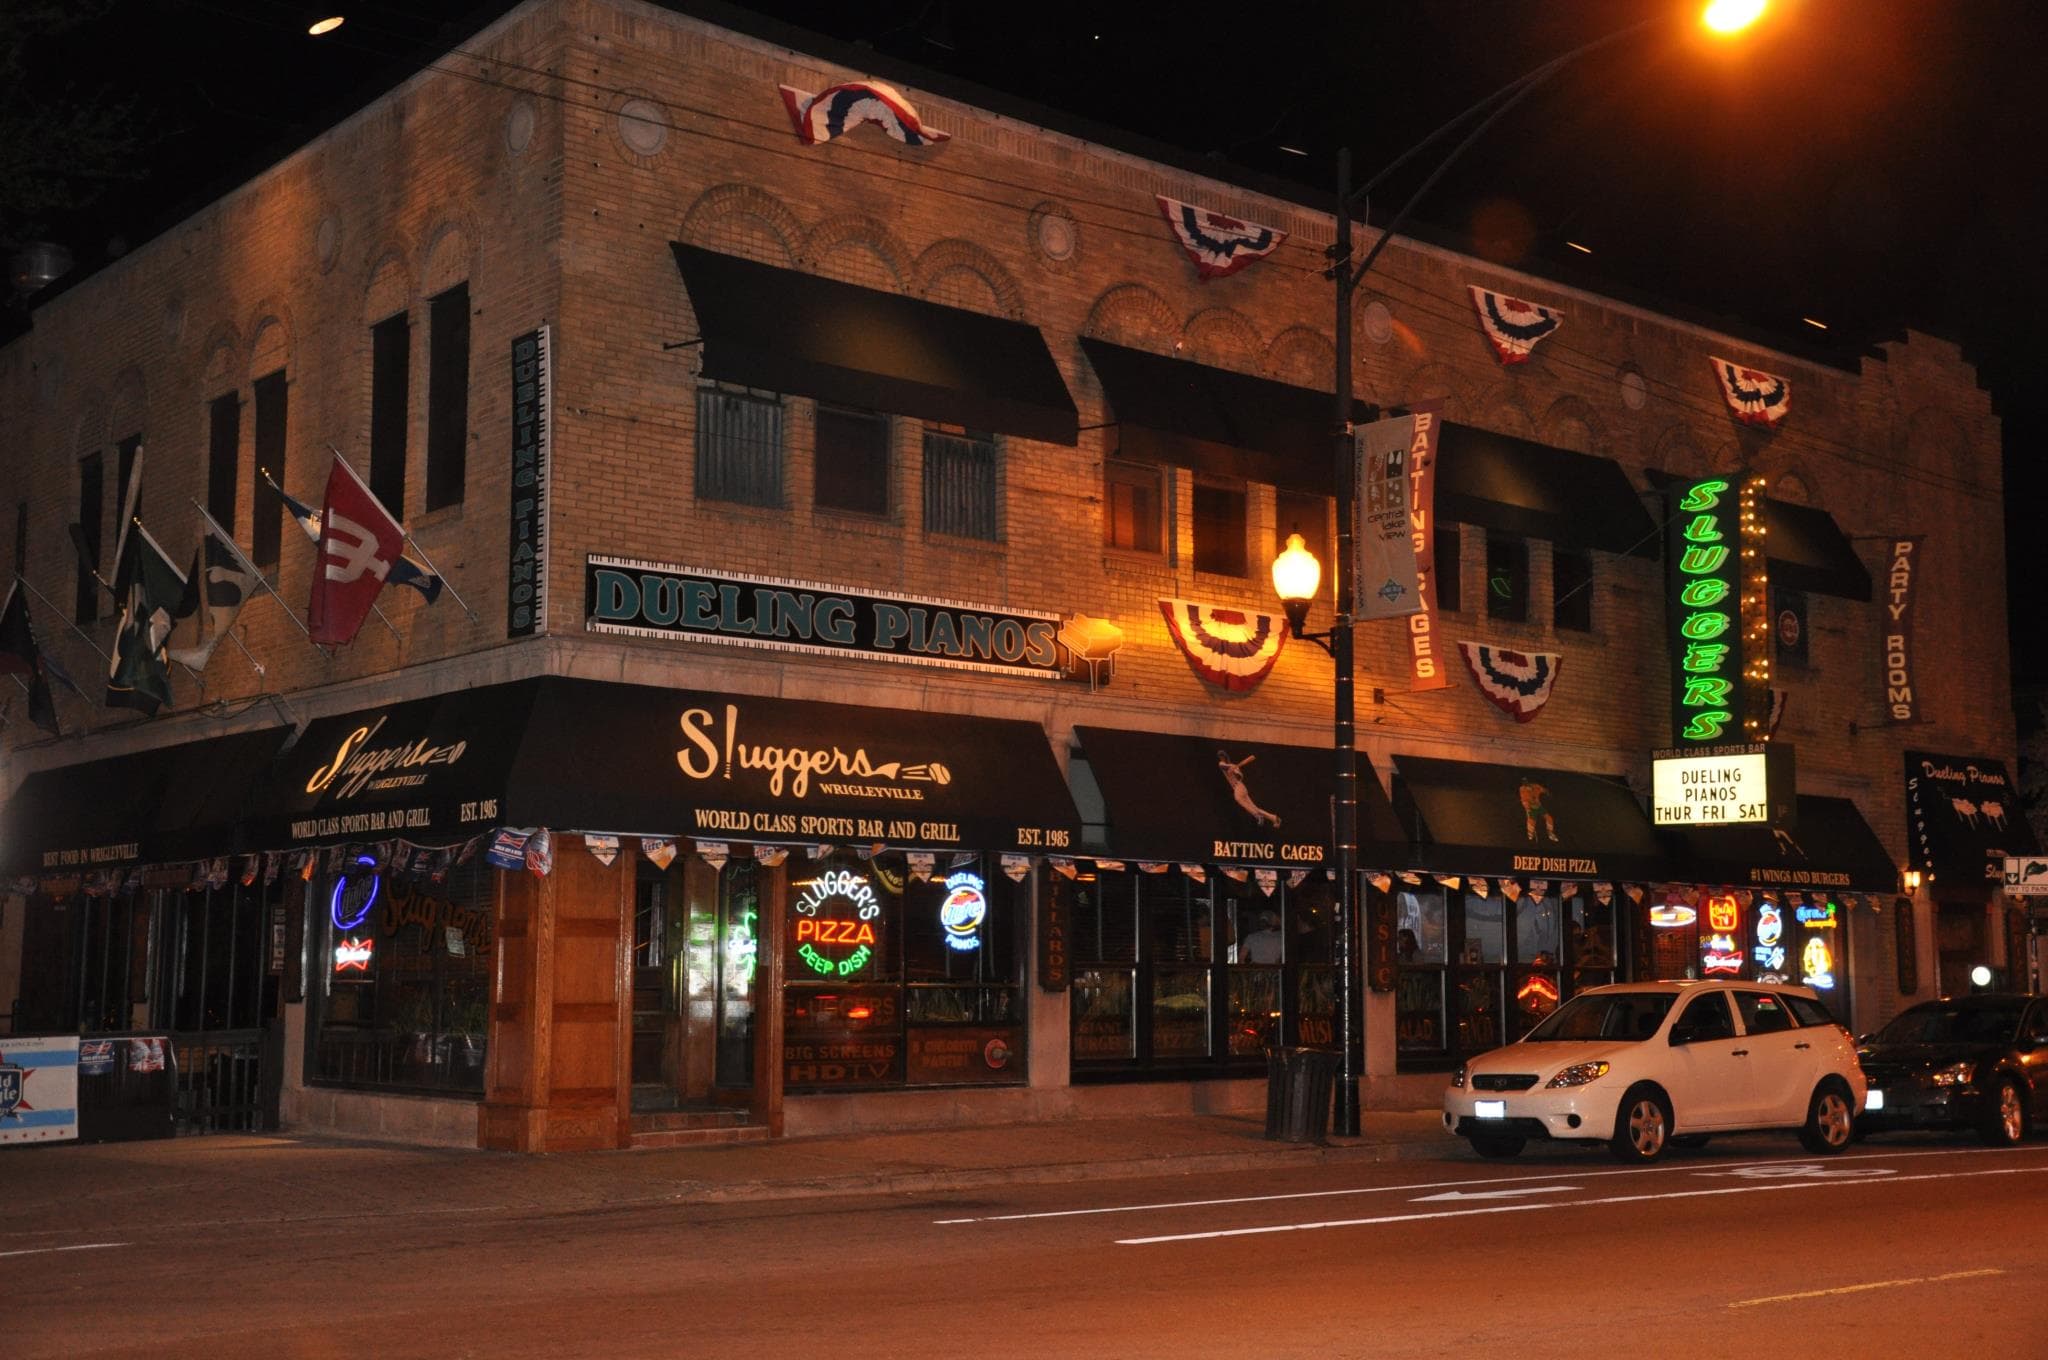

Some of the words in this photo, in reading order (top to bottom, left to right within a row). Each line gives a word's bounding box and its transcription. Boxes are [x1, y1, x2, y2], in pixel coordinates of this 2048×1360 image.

[515, 338, 535, 488] DUELING
[1410, 412, 1433, 553] BATTING
[1367, 508, 1406, 525] central
[513, 497, 534, 629] PIANOS
[1891, 542, 1914, 620] PARTY
[594, 569, 857, 644] DUELING
[873, 604, 1057, 666] PIANOS
[1680, 480, 1734, 740] SLUGGERS
[1888, 635, 1912, 720] ROOMS
[305, 715, 440, 800] Sluggers
[676, 704, 901, 799] Sluggers
[1653, 749, 1681, 759] WORLD
[1685, 747, 1710, 757] CLASS
[1714, 745, 1745, 755] SPORTS
[1748, 743, 1765, 753] BAR
[368, 774, 429, 790] WRIGLEYVILLE
[1682, 768, 1741, 784] DUELING
[1921, 760, 1967, 787] Dueling
[1966, 765, 2005, 785] Pianos
[819, 782, 924, 800] WRIGLEYVILLE
[1685, 786, 1737, 802] PIANOS
[460, 801, 477, 823] EST.
[479, 799, 497, 820] 1985
[1656, 806, 1692, 821] THUR
[1702, 805, 1725, 819] FRI
[1739, 803, 1766, 818] SAT
[291, 820, 317, 840] WORLD
[318, 817, 340, 836] CLASS
[341, 814, 369, 834] SPORTS
[371, 812, 386, 831] BAR
[387, 810, 405, 829] AND
[406, 808, 431, 827] GRILL
[694, 809, 751, 831] WORLD
[753, 813, 797, 833] CLASS
[800, 815, 854, 837] SPORTS
[858, 819, 884, 838] BAR
[888, 820, 916, 839] AND
[920, 821, 960, 842] GRILL
[1017, 826, 1044, 846] EST.
[1045, 827, 1070, 848] 1985
[43, 851, 59, 866] BEST
[60, 849, 79, 865] FOOD
[80, 848, 88, 864] IN
[91, 843, 139, 863] WRIGLEYVILLE
[1213, 840, 1274, 859] BATTING
[1281, 844, 1323, 861] CAGES
[1513, 855, 1541, 871] DEEP
[1542, 857, 1567, 872] DISH
[1568, 859, 1598, 874] PIZZA
[945, 872, 984, 890] DUELING
[1750, 868, 1761, 881] #1
[1762, 869, 1791, 882] WINGS
[1792, 870, 1810, 883] AND
[1811, 871, 1850, 886] BURGERS
[796, 870, 880, 921] SLUGGER'S
[797, 920, 874, 944] PIZZA
[1376, 903, 1392, 986] USIC
[798, 944, 834, 975] DEEP
[838, 945, 872, 976] DISH
[784, 1044, 814, 1060] BIG
[818, 1043, 897, 1060] SCREENS
[789, 1063, 889, 1081] HDTV
